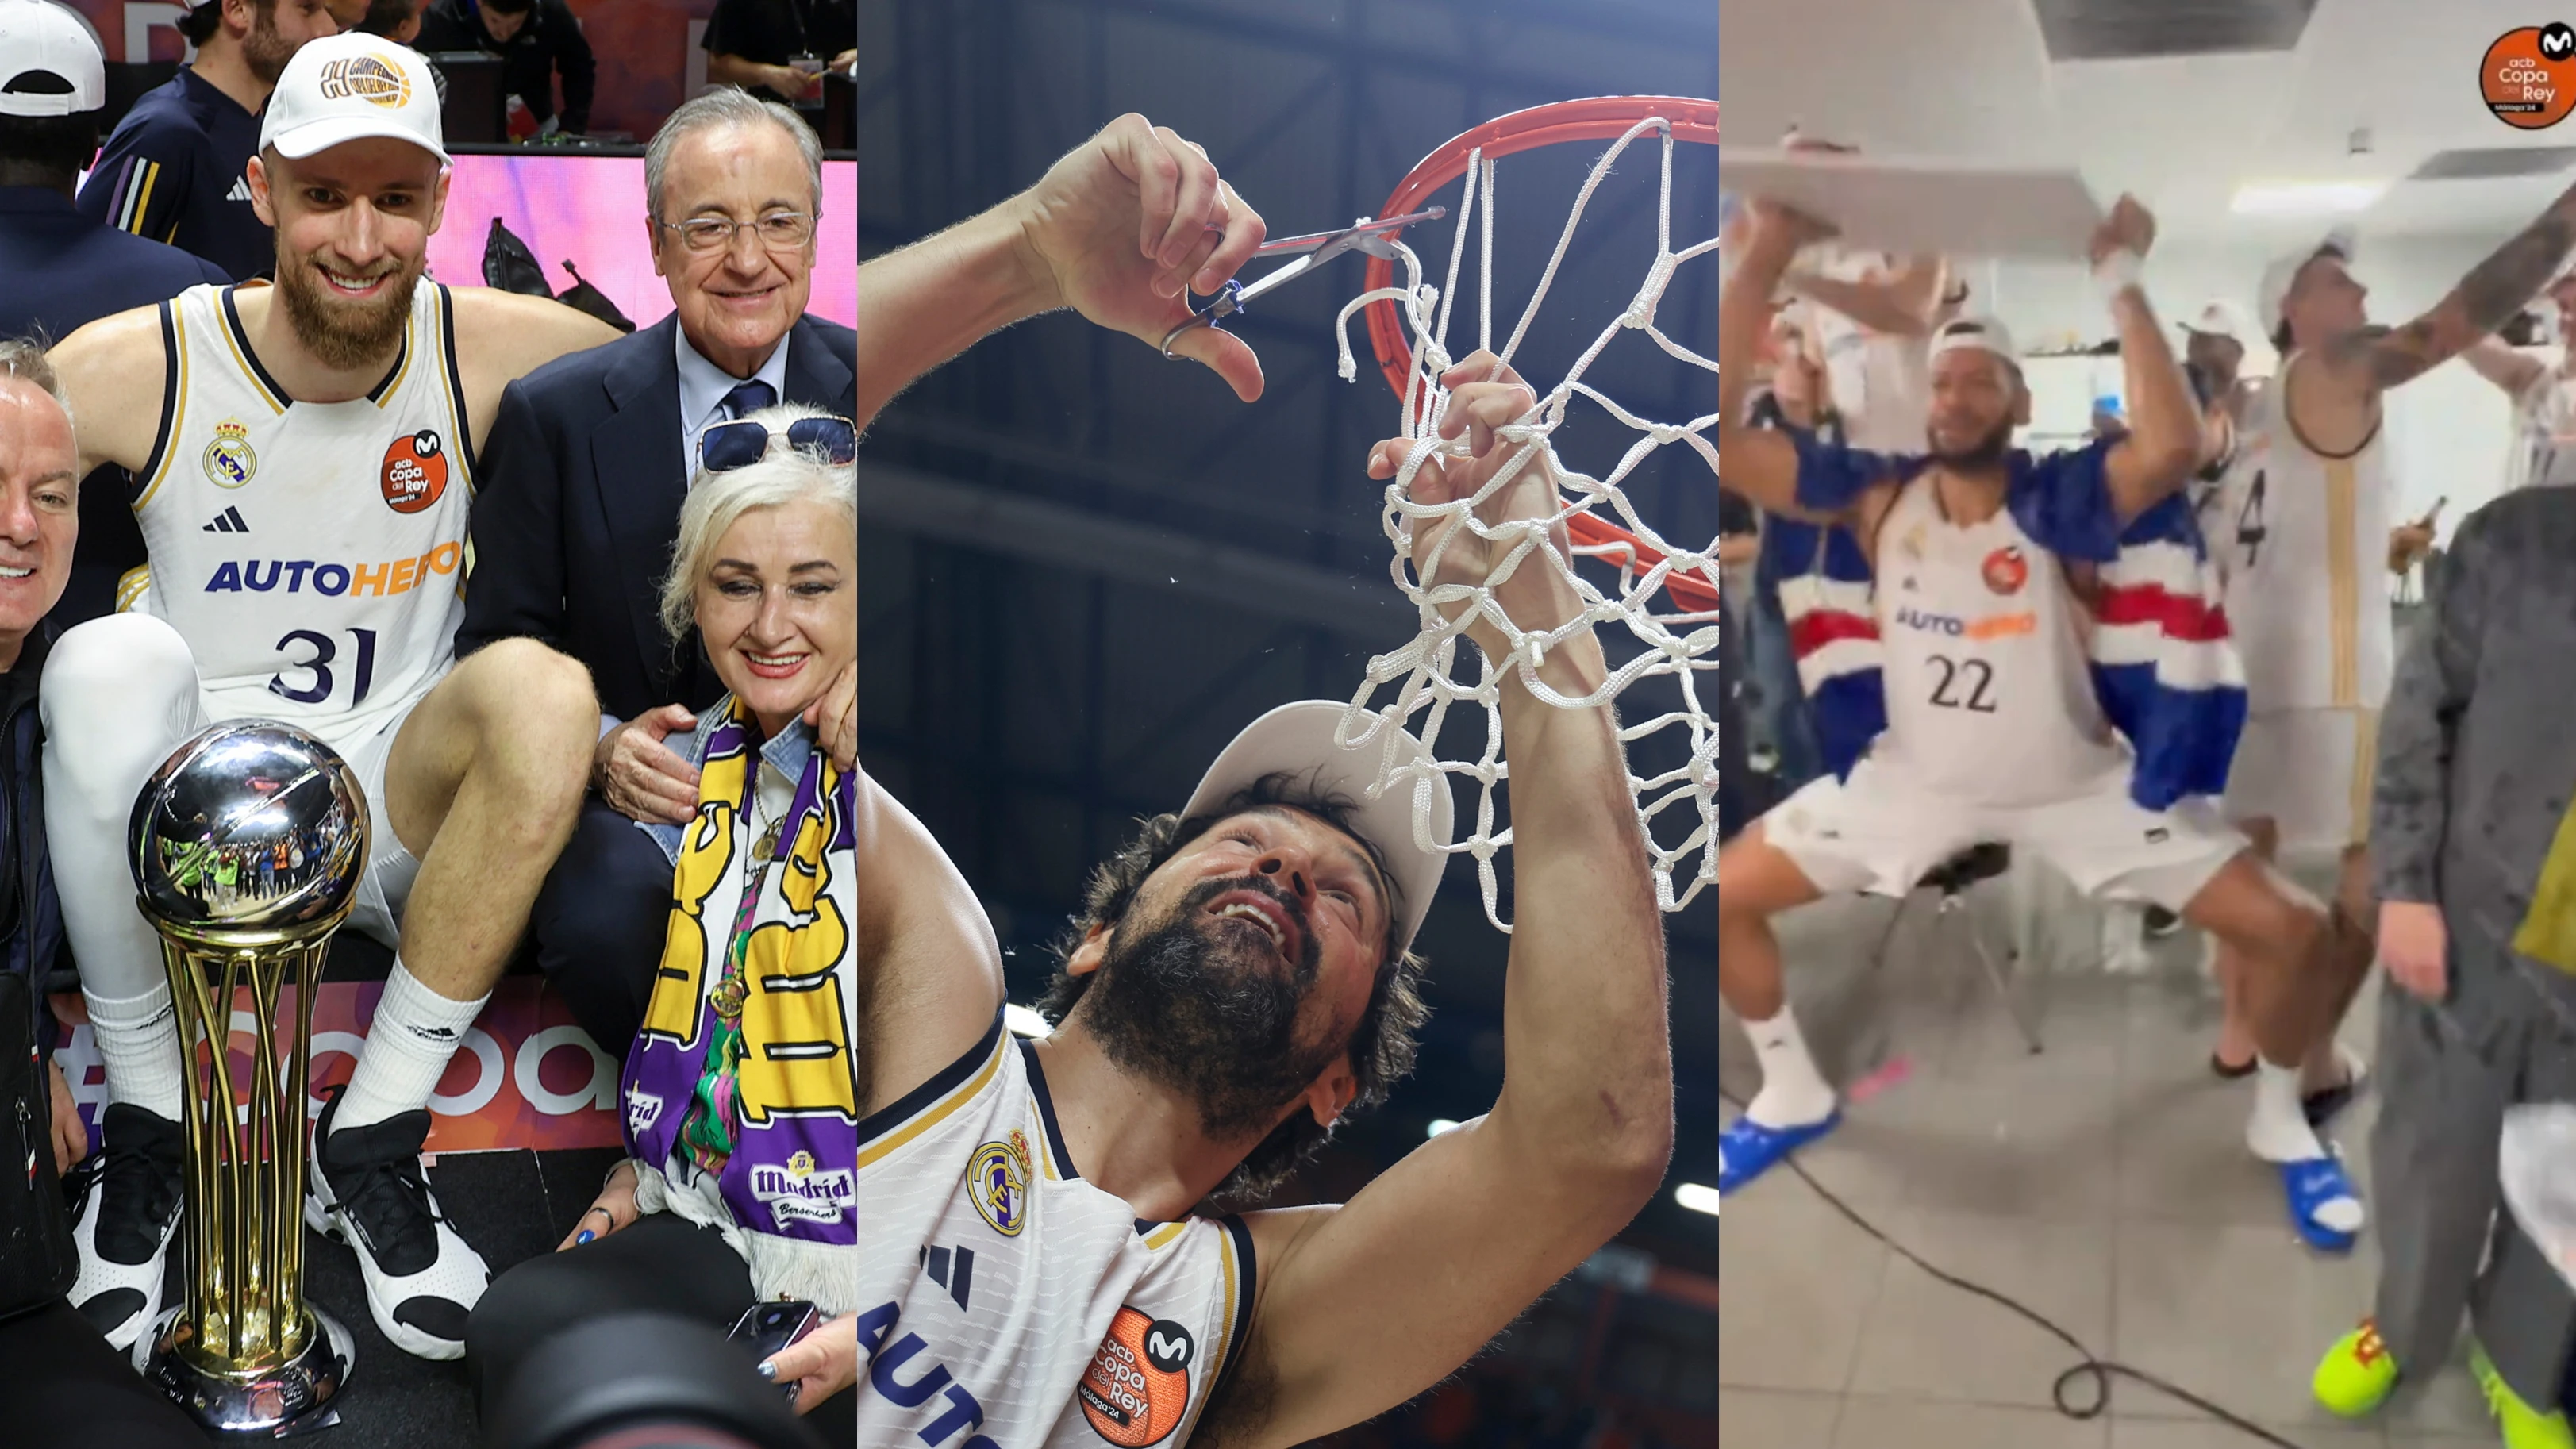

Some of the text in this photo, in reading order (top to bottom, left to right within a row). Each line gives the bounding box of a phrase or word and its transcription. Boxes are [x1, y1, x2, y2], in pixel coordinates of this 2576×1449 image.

[389, 467, 423, 482] Copa
[394, 458, 413, 470] acb
[204, 540, 462, 597] AUTOHERO
[1895, 607, 2037, 642] AUTOO
[267, 628, 377, 709] 31
[1924, 653, 1997, 713] 22
[755, 1170, 852, 1200] Madrid
[1095, 1344, 1146, 1390] Copa
[1107, 1339, 1135, 1363] acb
[857, 1300, 1002, 1449] AUT
[1092, 1367, 1148, 1418] del Rey
